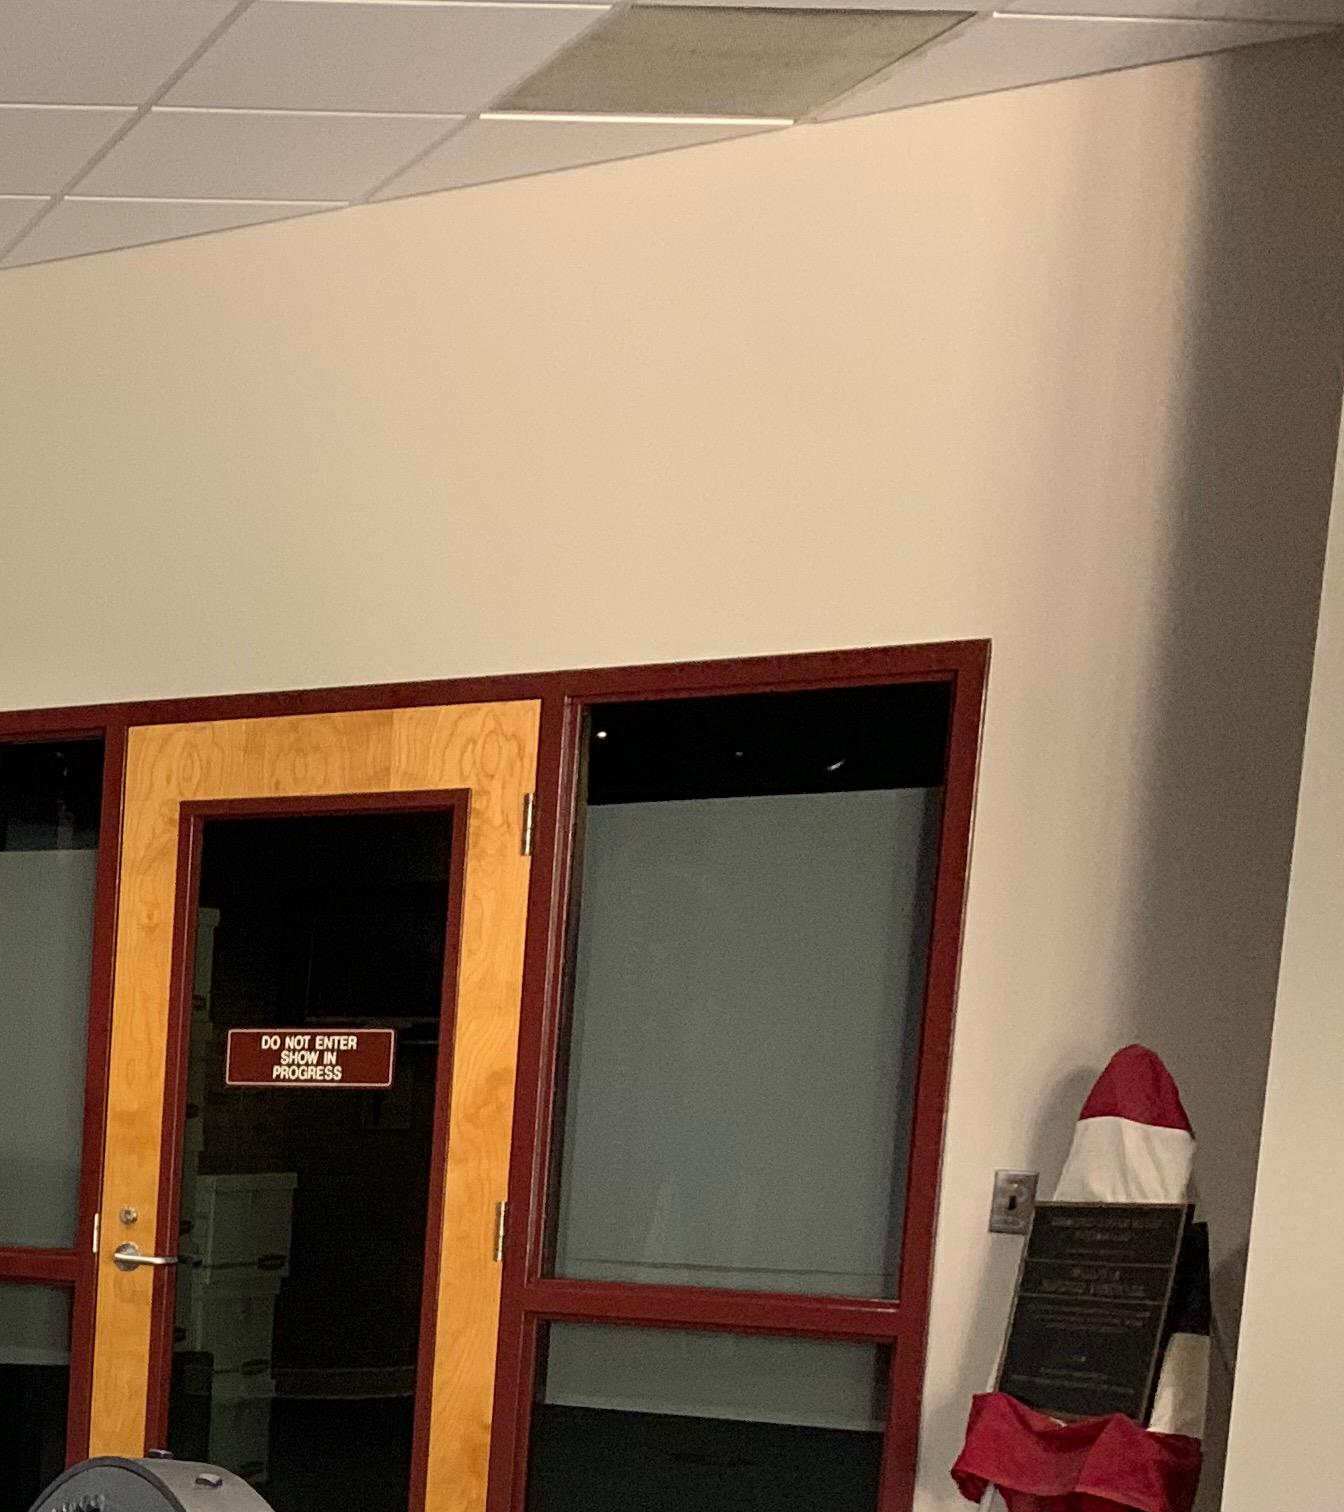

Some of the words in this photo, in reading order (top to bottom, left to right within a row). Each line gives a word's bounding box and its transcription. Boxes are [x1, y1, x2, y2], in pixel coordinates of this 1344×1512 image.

[261, 1036, 281, 1050] DO
[285, 1035, 311, 1050] NOT
[315, 1035, 358, 1050] ENTER
[280, 1051, 320, 1065] SHOW
[323, 1051, 337, 1065] IN
[272, 1066, 342, 1080] PROGRESS
